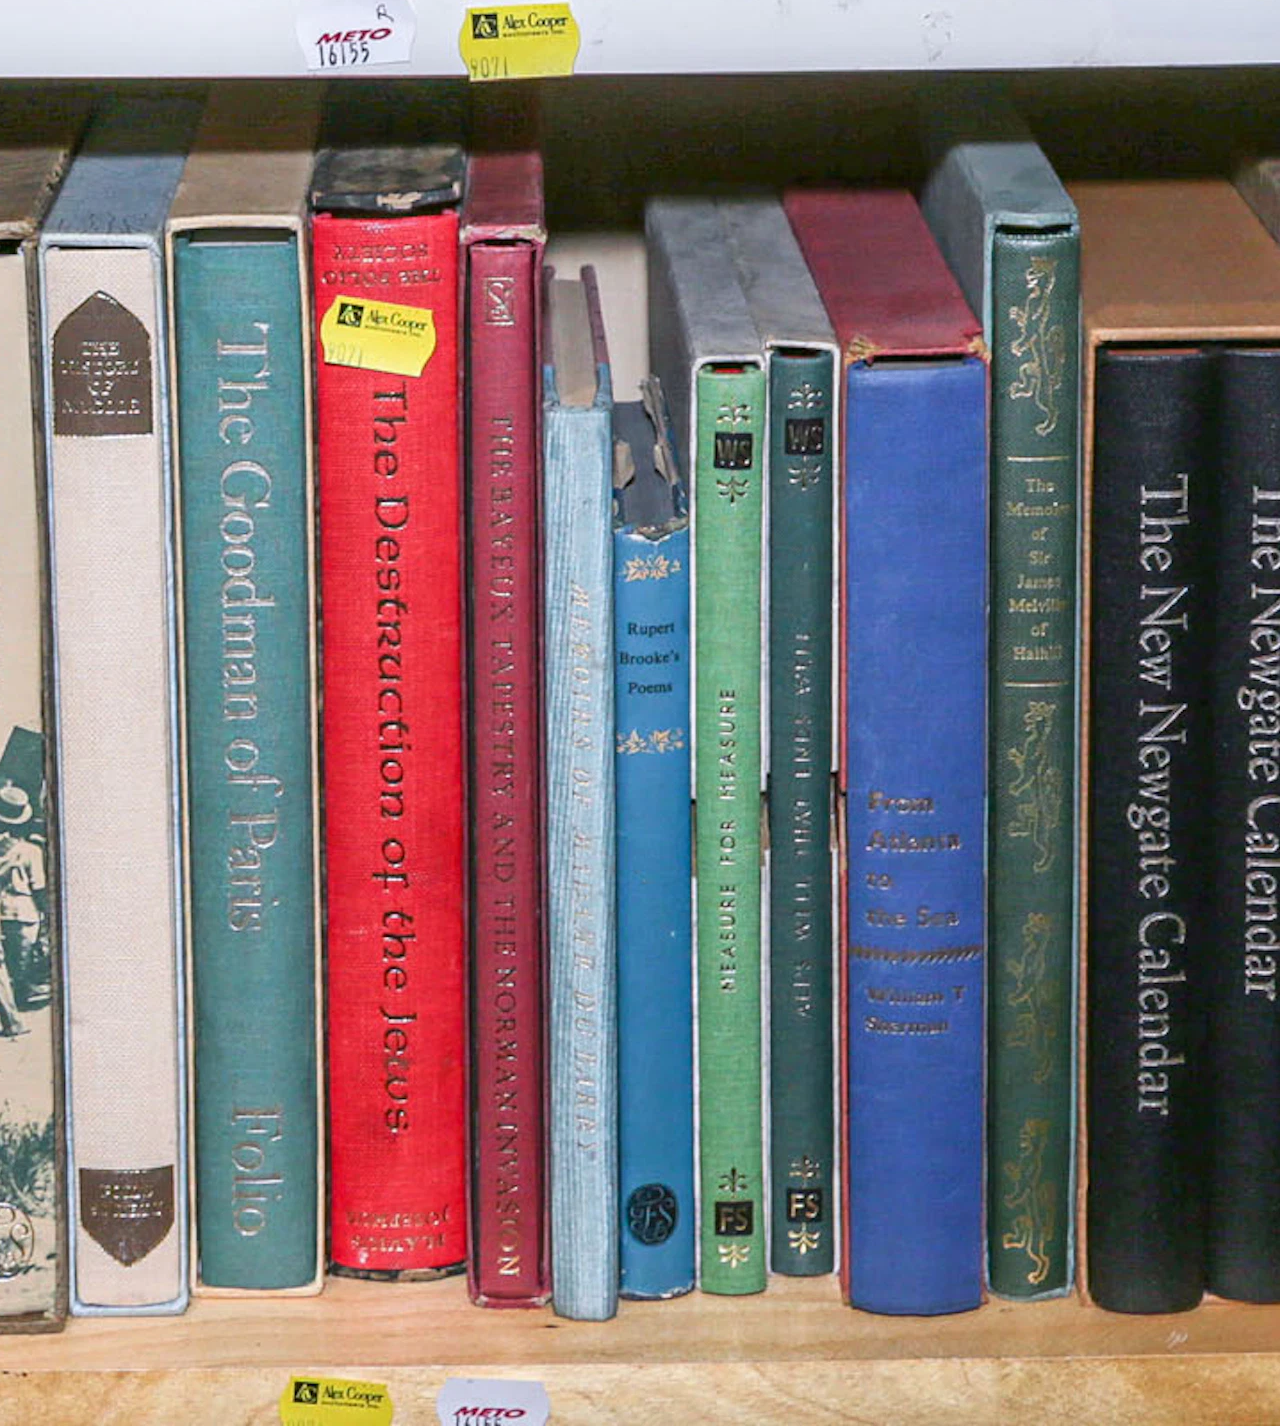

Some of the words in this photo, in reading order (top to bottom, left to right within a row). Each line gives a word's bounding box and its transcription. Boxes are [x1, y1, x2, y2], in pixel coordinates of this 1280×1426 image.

[316, 28, 392, 44] METO
[319, 43, 370, 66] 16155
[503, 15, 526, 30] Alex
[528, 13, 568, 28] Cooper
[367, 308, 388, 325] Alex
[391, 312, 428, 332] Cooper
[217, 321, 272, 446] The
[372, 380, 408, 478] The
[1139, 473, 1190, 572] The
[220, 461, 276, 721] Goodman
[374, 494, 410, 821] Destruction
[620, 652, 680, 665] Brooke's
[628, 622, 675, 636] Rupert
[1138, 584, 1189, 691] New
[628, 682, 672, 694] Poems
[226, 738, 283, 797] of
[720, 690, 736, 799] MEASURE
[1126, 698, 1188, 899] Newgate
[227, 819, 281, 934] Paris
[373, 840, 411, 891] of
[720, 820, 736, 866] FOR
[383, 911, 416, 993] the
[1137, 911, 1188, 1116] Calendar
[231, 1103, 283, 1238] Folio
[322, 1385, 344, 1400] Alex
[346, 1385, 384, 1404] Cooper
[454, 1407, 526, 1418] METO
